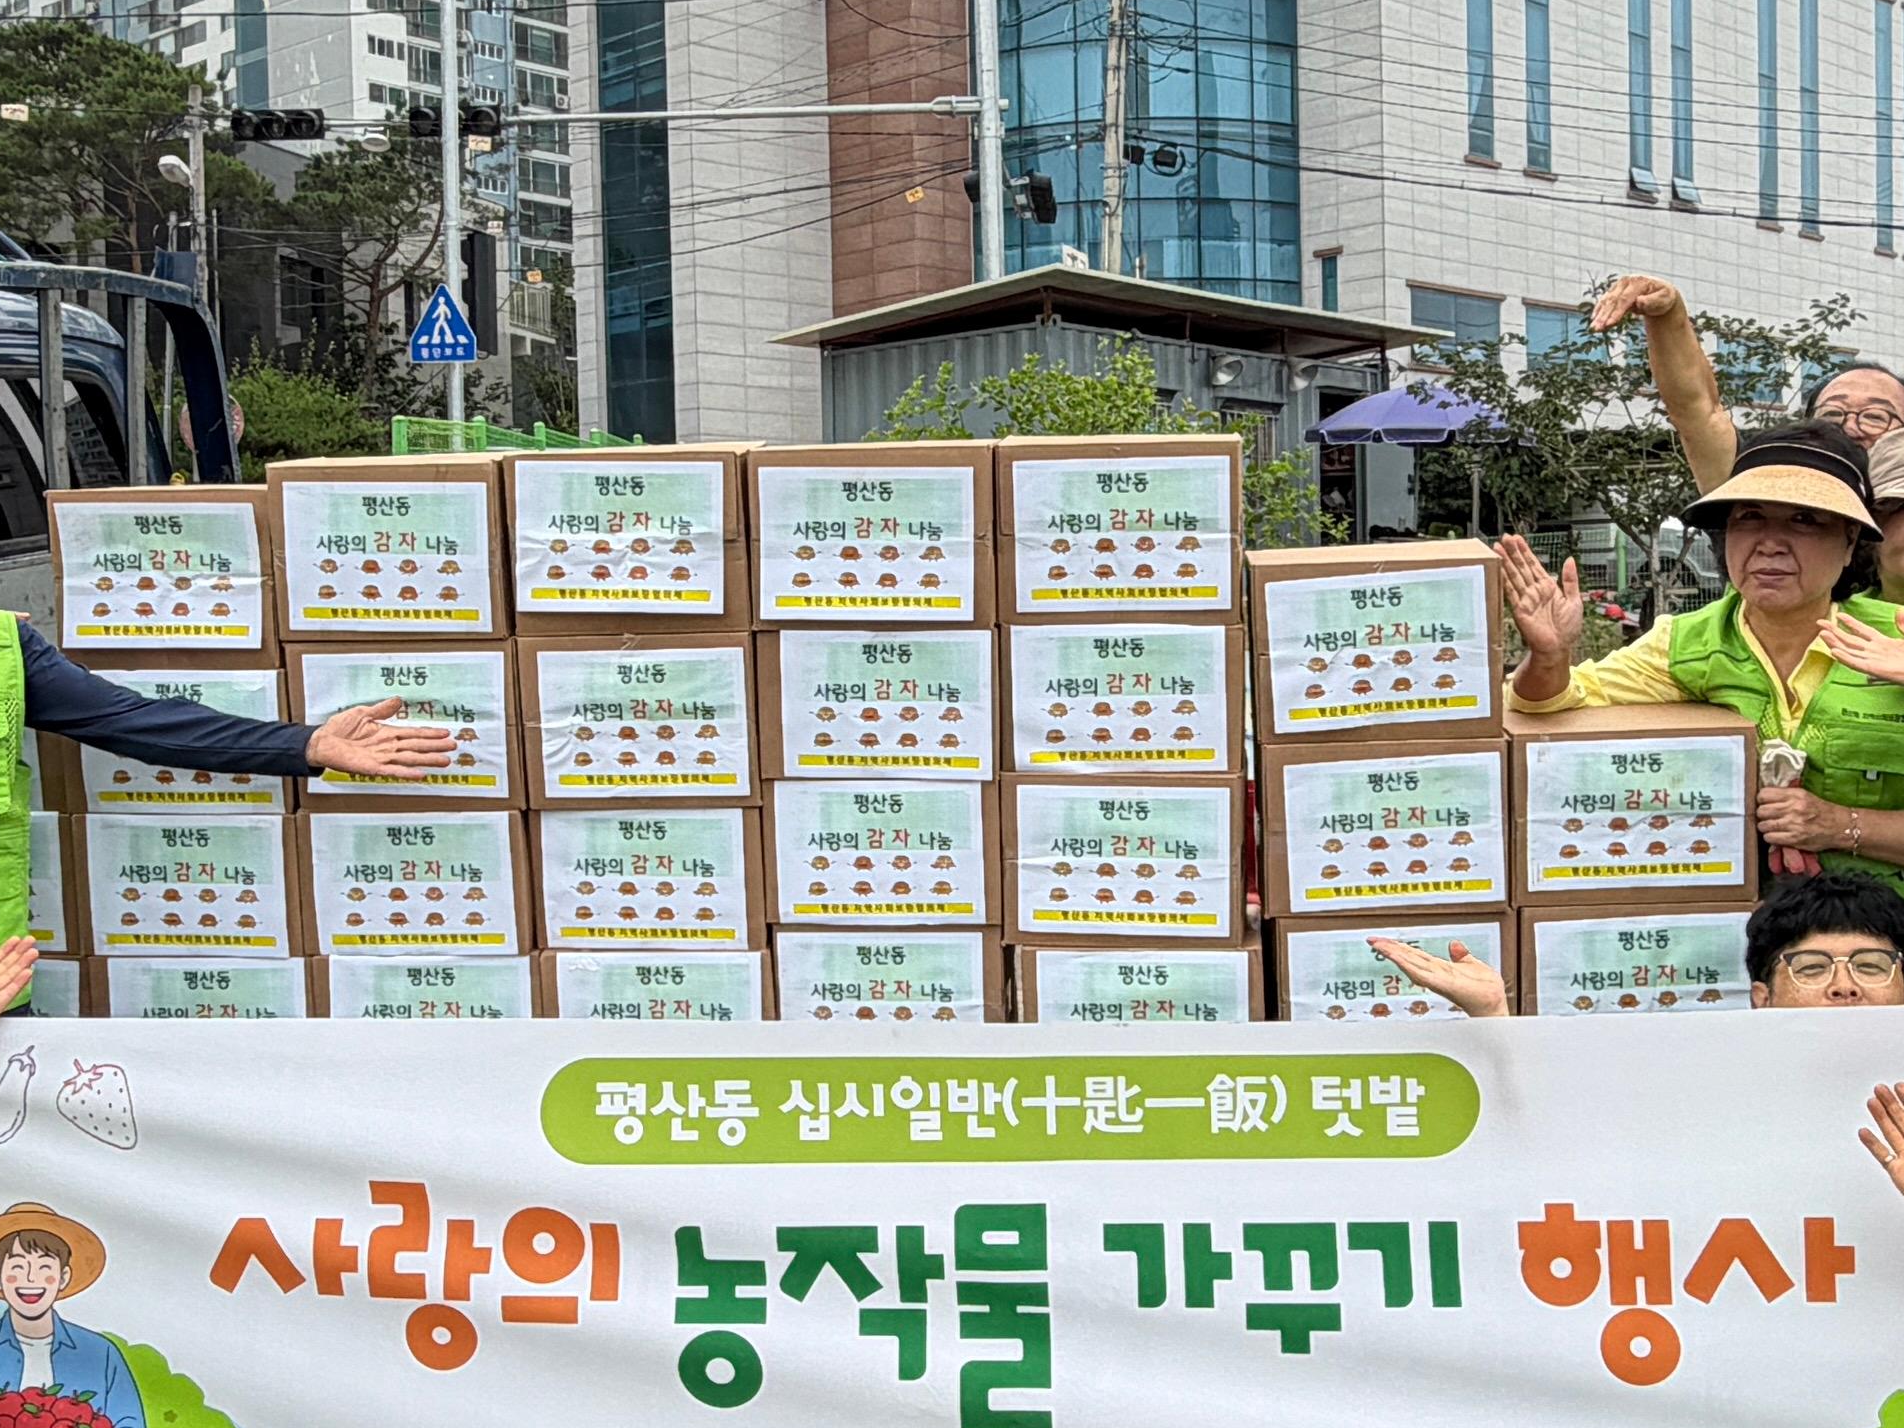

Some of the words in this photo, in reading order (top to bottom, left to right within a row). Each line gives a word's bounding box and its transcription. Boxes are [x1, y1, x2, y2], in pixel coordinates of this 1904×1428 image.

[594, 474, 645, 497] 평산동
[841, 480, 894, 502] 평산동
[1095, 471, 1149, 494] 평산동
[360, 495, 411, 517] 평산동
[135, 514, 185, 536] 평산동
[546, 513, 599, 535] 사랑의
[658, 514, 693, 535] 나눔
[792, 520, 846, 542] 사랑의
[907, 520, 943, 542] 나눔
[1047, 512, 1102, 535] 사랑의
[1162, 510, 1200, 532] 나눔
[315, 533, 367, 555] 사랑의
[424, 534, 459, 556] 나눔
[91, 552, 142, 573] 사랑의
[197, 552, 231, 573] 나눔
[1349, 585, 1404, 611] 평산동
[1302, 628, 1358, 652] 사랑의
[1418, 621, 1456, 643] 나눔
[860, 642, 913, 665] 평산동
[1092, 637, 1145, 659] 평산동
[379, 665, 428, 686] 평산동
[615, 663, 667, 685] 평산동
[813, 682, 866, 703] 사랑의
[926, 681, 963, 703] 나눔
[1044, 676, 1099, 699] 사랑의
[1159, 675, 1195, 696] 나눔
[441, 703, 476, 724] 나눔
[571, 701, 623, 723] 사랑의
[681, 700, 716, 721] 나눔
[1610, 752, 1664, 775] 평산동
[1366, 770, 1420, 794] 평산동
[852, 793, 904, 815] 평산동
[1098, 799, 1150, 821] 평산동
[1560, 792, 1616, 814] 사랑의
[1677, 789, 1714, 810] 나눔
[617, 820, 667, 841] 평산동
[1319, 811, 1374, 834] 사랑의
[1434, 806, 1472, 827] 나눔
[160, 828, 209, 848] 평산동
[385, 825, 435, 847] 평산동
[807, 831, 859, 852] 사랑의
[917, 830, 954, 851] 나눔
[1049, 837, 1103, 858] 사랑의
[1163, 839, 1200, 860] 나눔
[118, 864, 168, 884] 사랑의
[223, 865, 257, 885] 나눔
[343, 863, 394, 884] 사랑의
[449, 862, 484, 882] 나눔
[573, 857, 624, 877] 사랑의
[681, 857, 716, 878] 나눔
[1617, 928, 1670, 952] 평산동
[855, 945, 906, 966] 평산동
[182, 970, 231, 990] 평산동
[406, 966, 456, 987] 평산동
[635, 965, 686, 986] 평산동
[1117, 964, 1169, 985] 평산동
[1569, 969, 1624, 992] 사랑의
[1684, 964, 1721, 985] 나눔
[809, 982, 862, 1003] 사랑의
[919, 982, 954, 1003] 나눔
[1321, 978, 1375, 1000] 사랑의
[589, 1001, 641, 1019] 사랑의
[698, 1002, 734, 1019] 나눔
[1069, 1001, 1123, 1022] 사랑의
[1182, 1002, 1219, 1022] 나눔
[594, 1079, 760, 1148] 평산동
[780, 1074, 1289, 1142] 십시일반(十匙一飯)
[1311, 1075, 1426, 1139] 텃밭
[209, 1179, 621, 1371] 사랑의
[1103, 1221, 1463, 1355] 가꾸기
[1517, 1202, 1856, 1387] 행사
